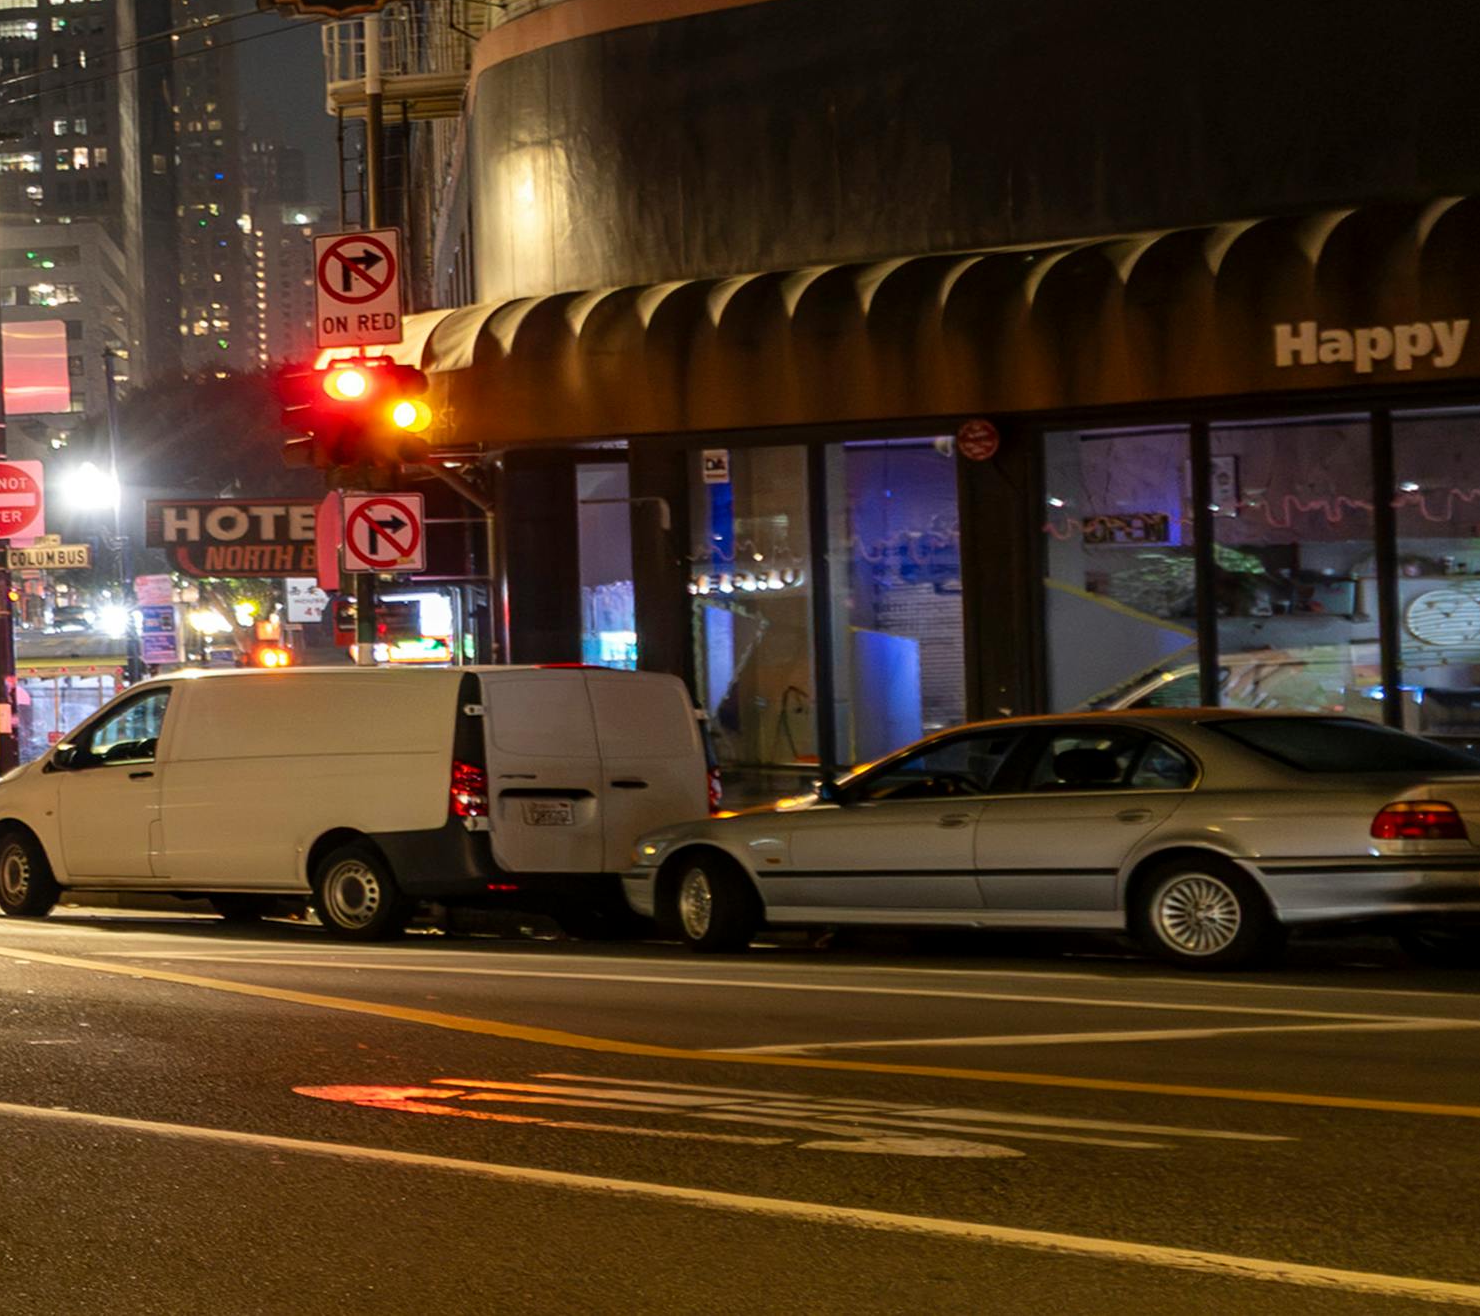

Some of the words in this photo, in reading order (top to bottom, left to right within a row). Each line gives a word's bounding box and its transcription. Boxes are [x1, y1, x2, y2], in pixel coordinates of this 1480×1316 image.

[322, 316, 348, 335] ON
[358, 312, 396, 333] RED
[1274, 319, 1471, 374] Happy
[10, 550, 85, 566] COLUMBUS
[206, 546, 294, 569] NORTH
